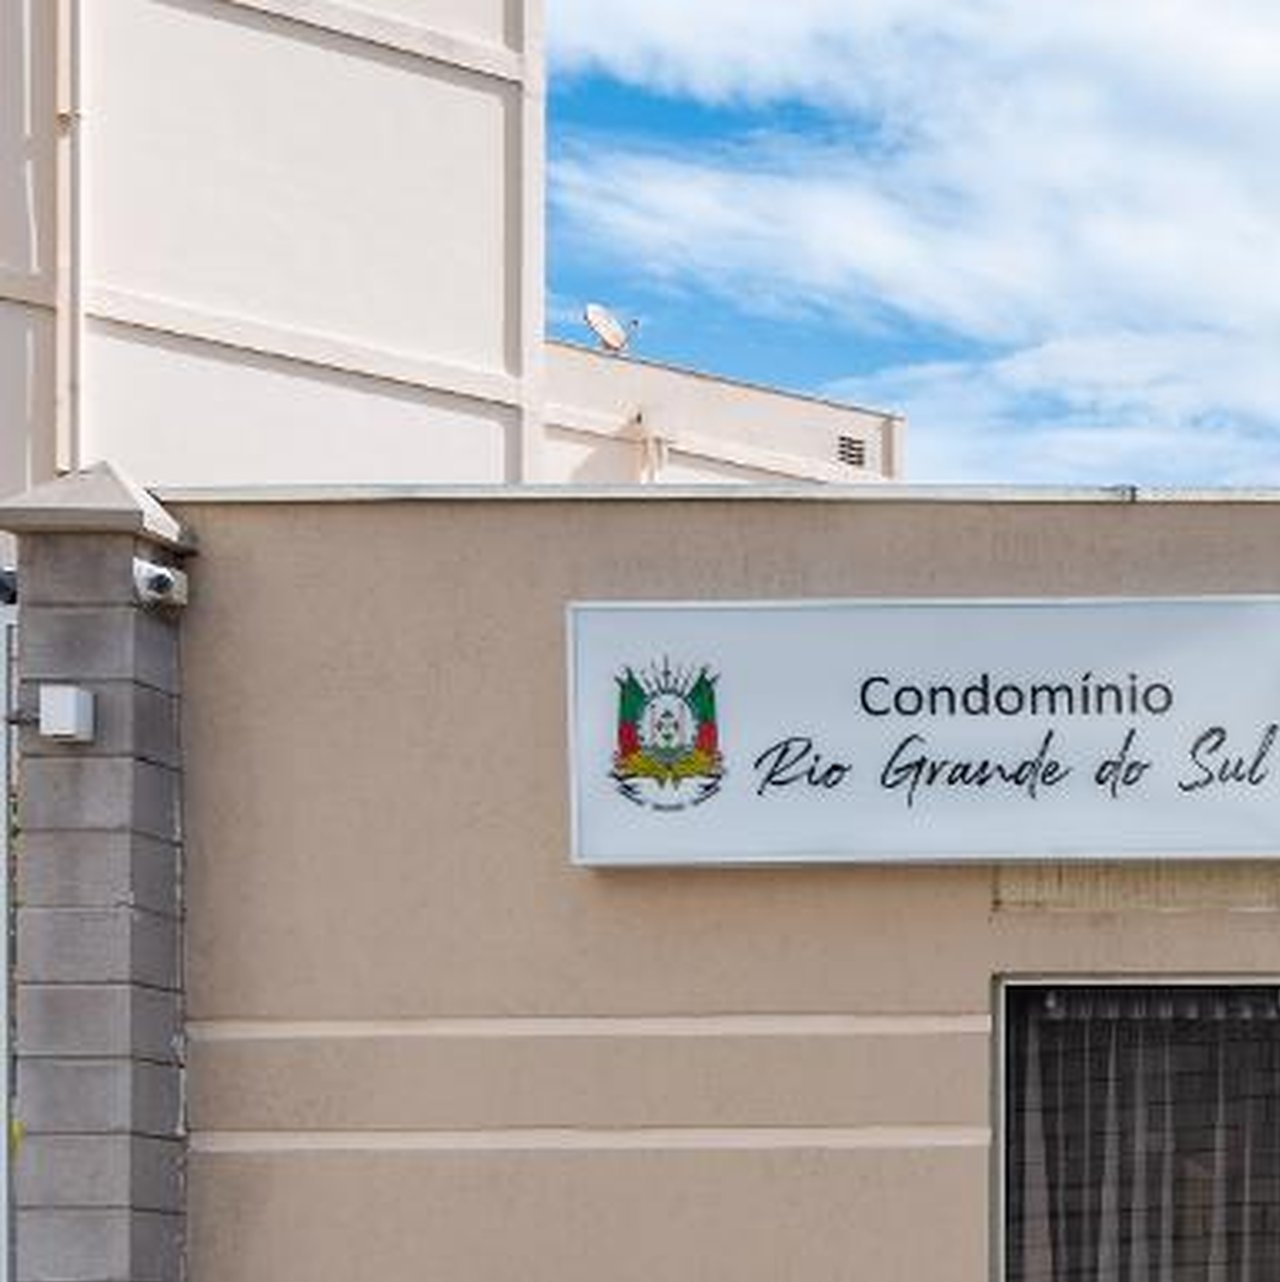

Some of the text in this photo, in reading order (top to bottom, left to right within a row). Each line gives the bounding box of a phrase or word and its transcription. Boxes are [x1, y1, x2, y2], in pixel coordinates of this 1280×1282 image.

[858, 671, 1175, 718] Condomínio
[752, 722, 1280, 808] Rio Grande do Sul
